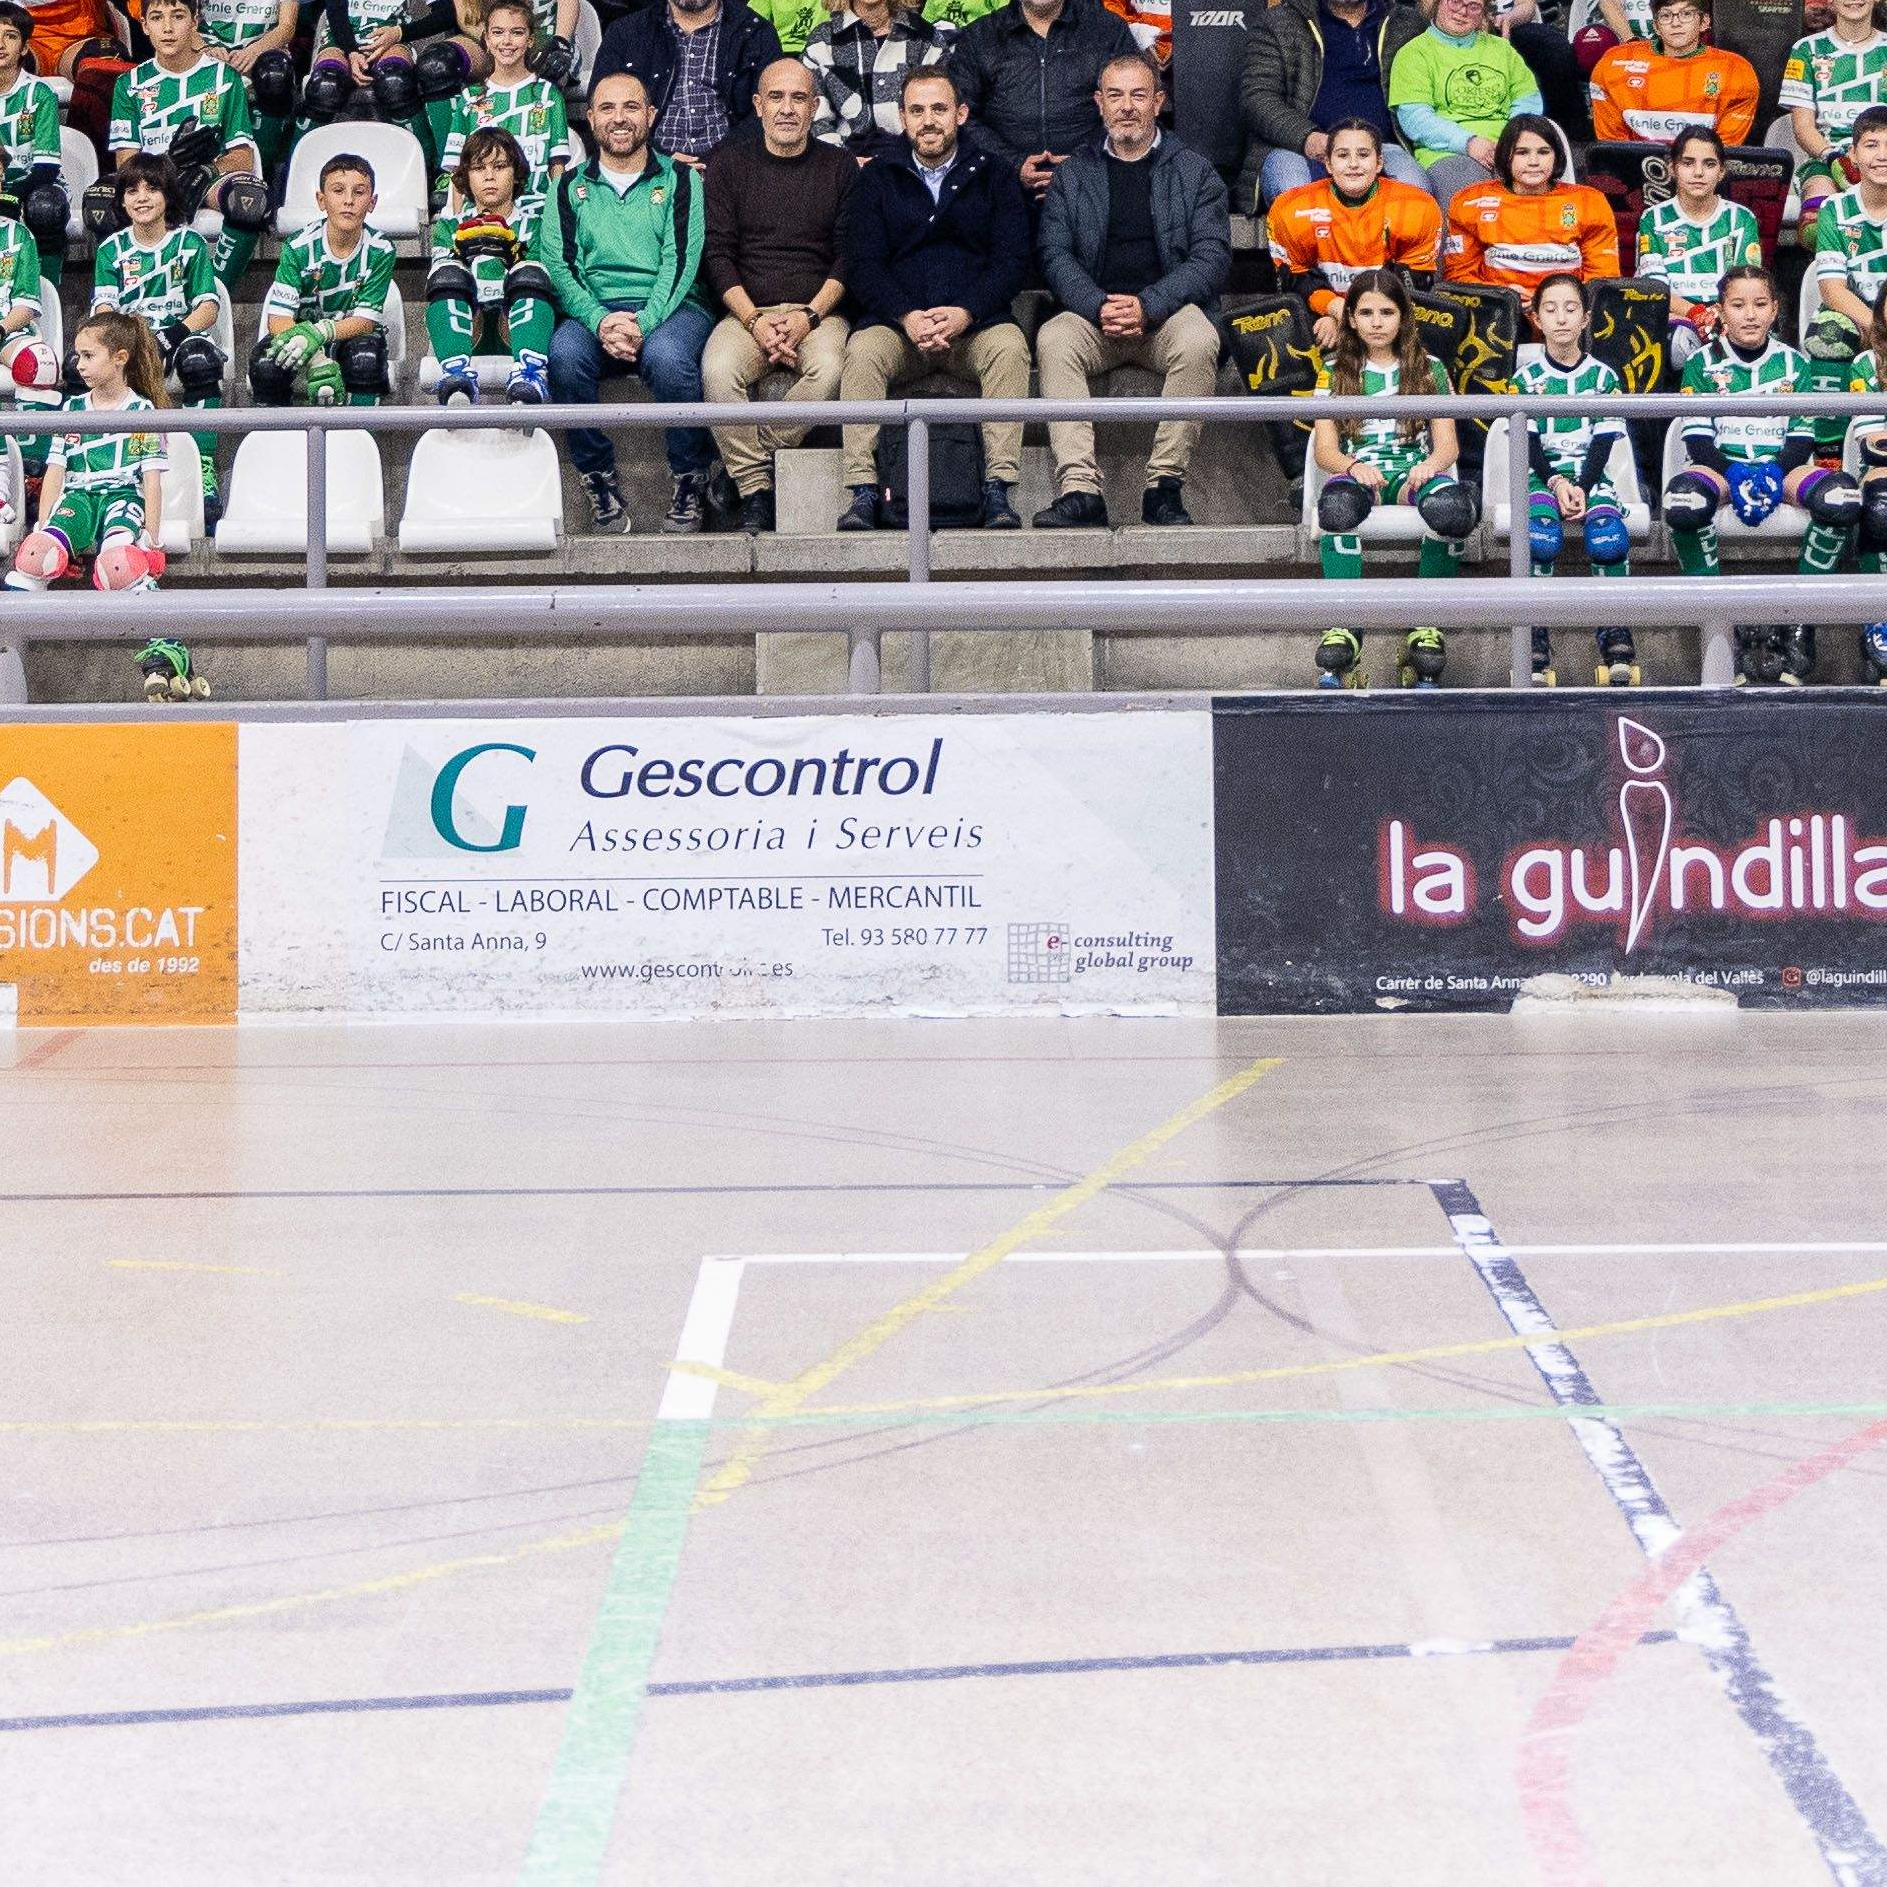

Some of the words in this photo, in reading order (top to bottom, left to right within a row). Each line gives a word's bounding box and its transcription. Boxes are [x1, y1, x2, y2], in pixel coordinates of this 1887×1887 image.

[581, 737, 943, 799] Gescontrol
[570, 820, 785, 852] Assessoria
[807, 819, 818, 850] i
[836, 817, 983, 850] Serveis
[1390, 821, 1465, 914] la
[382, 890, 470, 913] FISCAL
[496, 889, 618, 913] LABORAL
[643, 887, 803, 912] COMPTABLE
[829, 885, 982, 910] MERCANTIL
[380, 932, 403, 952] C/
[409, 933, 465, 951] Santa
[471, 932, 528, 954] Anna,
[534, 932, 548, 950] 9
[822, 928, 850, 947] Tel.
[859, 928, 885, 946] 93
[892, 928, 929, 946] 580
[935, 927, 958, 945] 77
[964, 927, 989, 944] 77
[1074, 932, 1173, 952] consulting
[89, 958, 120, 973] des
[127, 958, 150, 973] de
[157, 956, 199, 973] 1992
[1075, 951, 1133, 973] global
[1137, 956, 1193, 973] group
[1425, 976, 1443, 990] de
[1447, 976, 1487, 990] Santa
